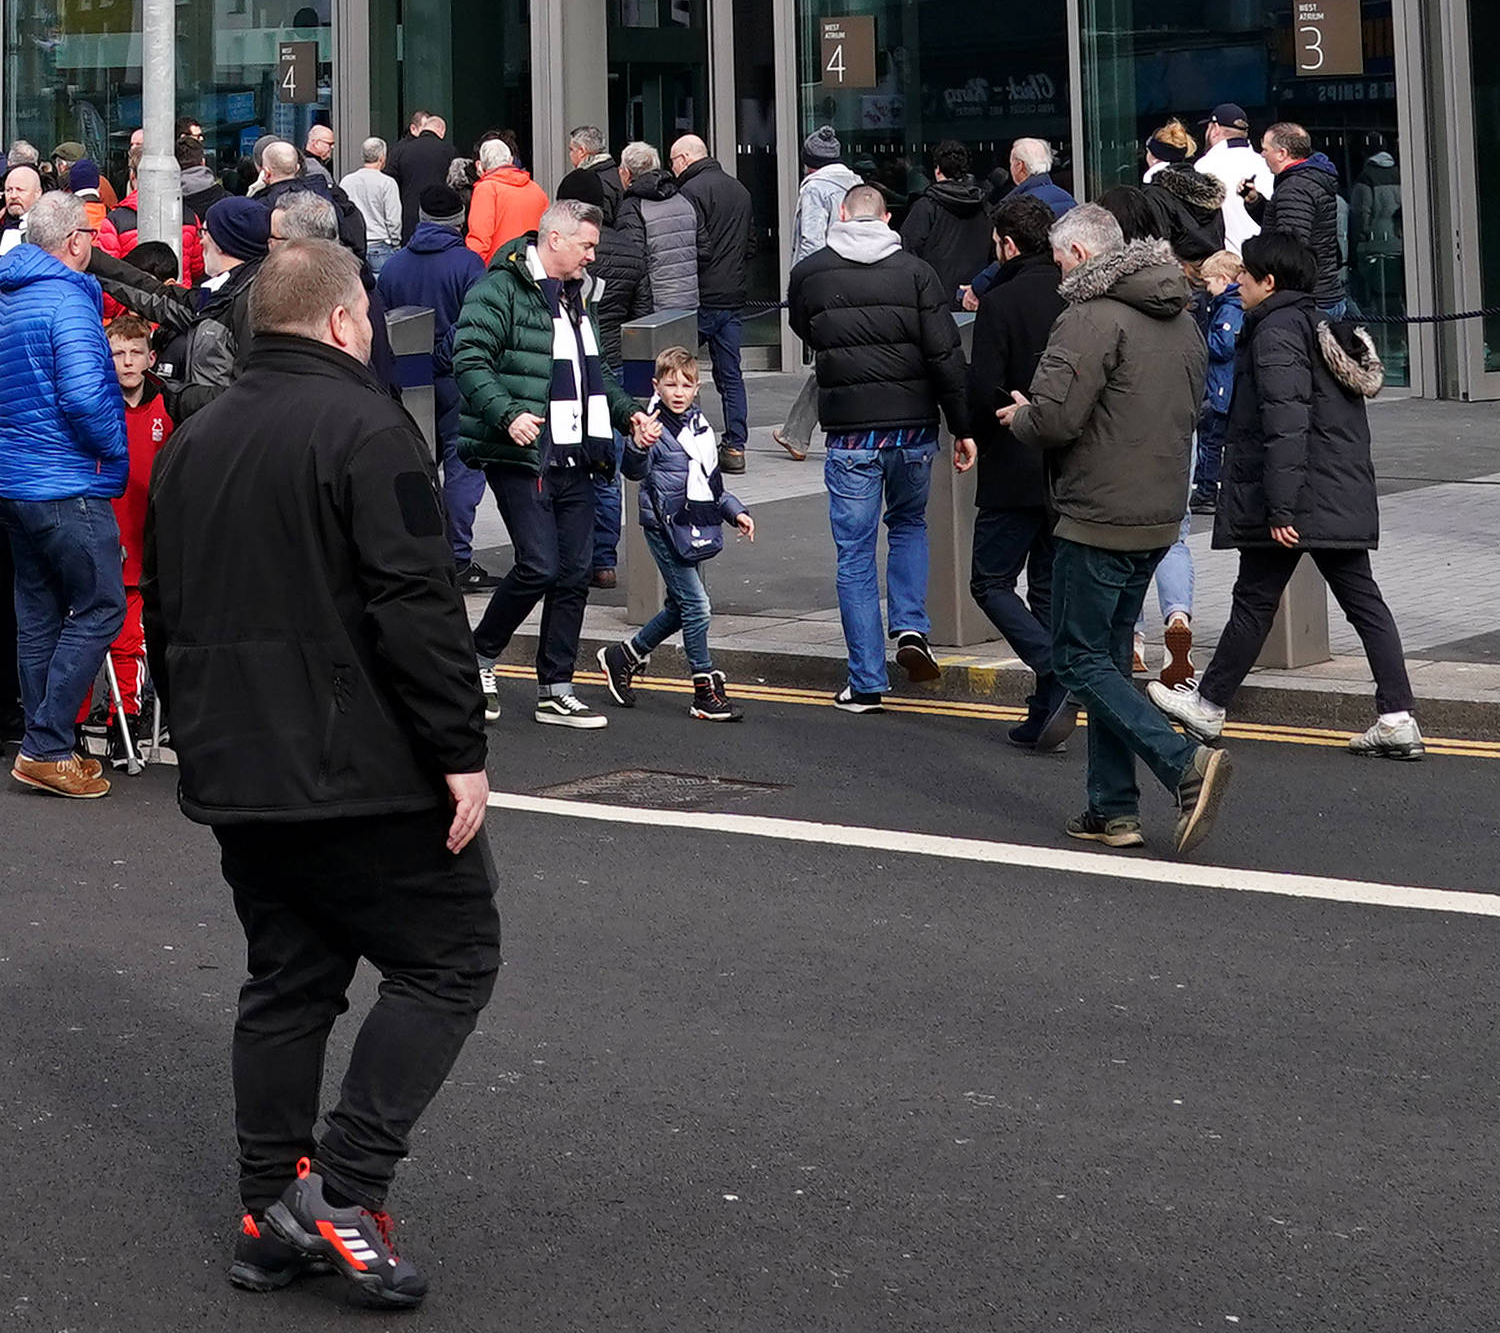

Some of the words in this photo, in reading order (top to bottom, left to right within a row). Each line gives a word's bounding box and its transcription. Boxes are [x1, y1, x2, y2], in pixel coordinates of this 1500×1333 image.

[1299, 3, 1318, 12] WEST
[1299, 12, 1325, 21] ATRIUM
[824, 23, 841, 32] WEST
[824, 31, 846, 39] ATRIUM
[1299, 26, 1325, 71] 3
[826, 44, 847, 83] 4
[281, 64, 297, 99] 4
